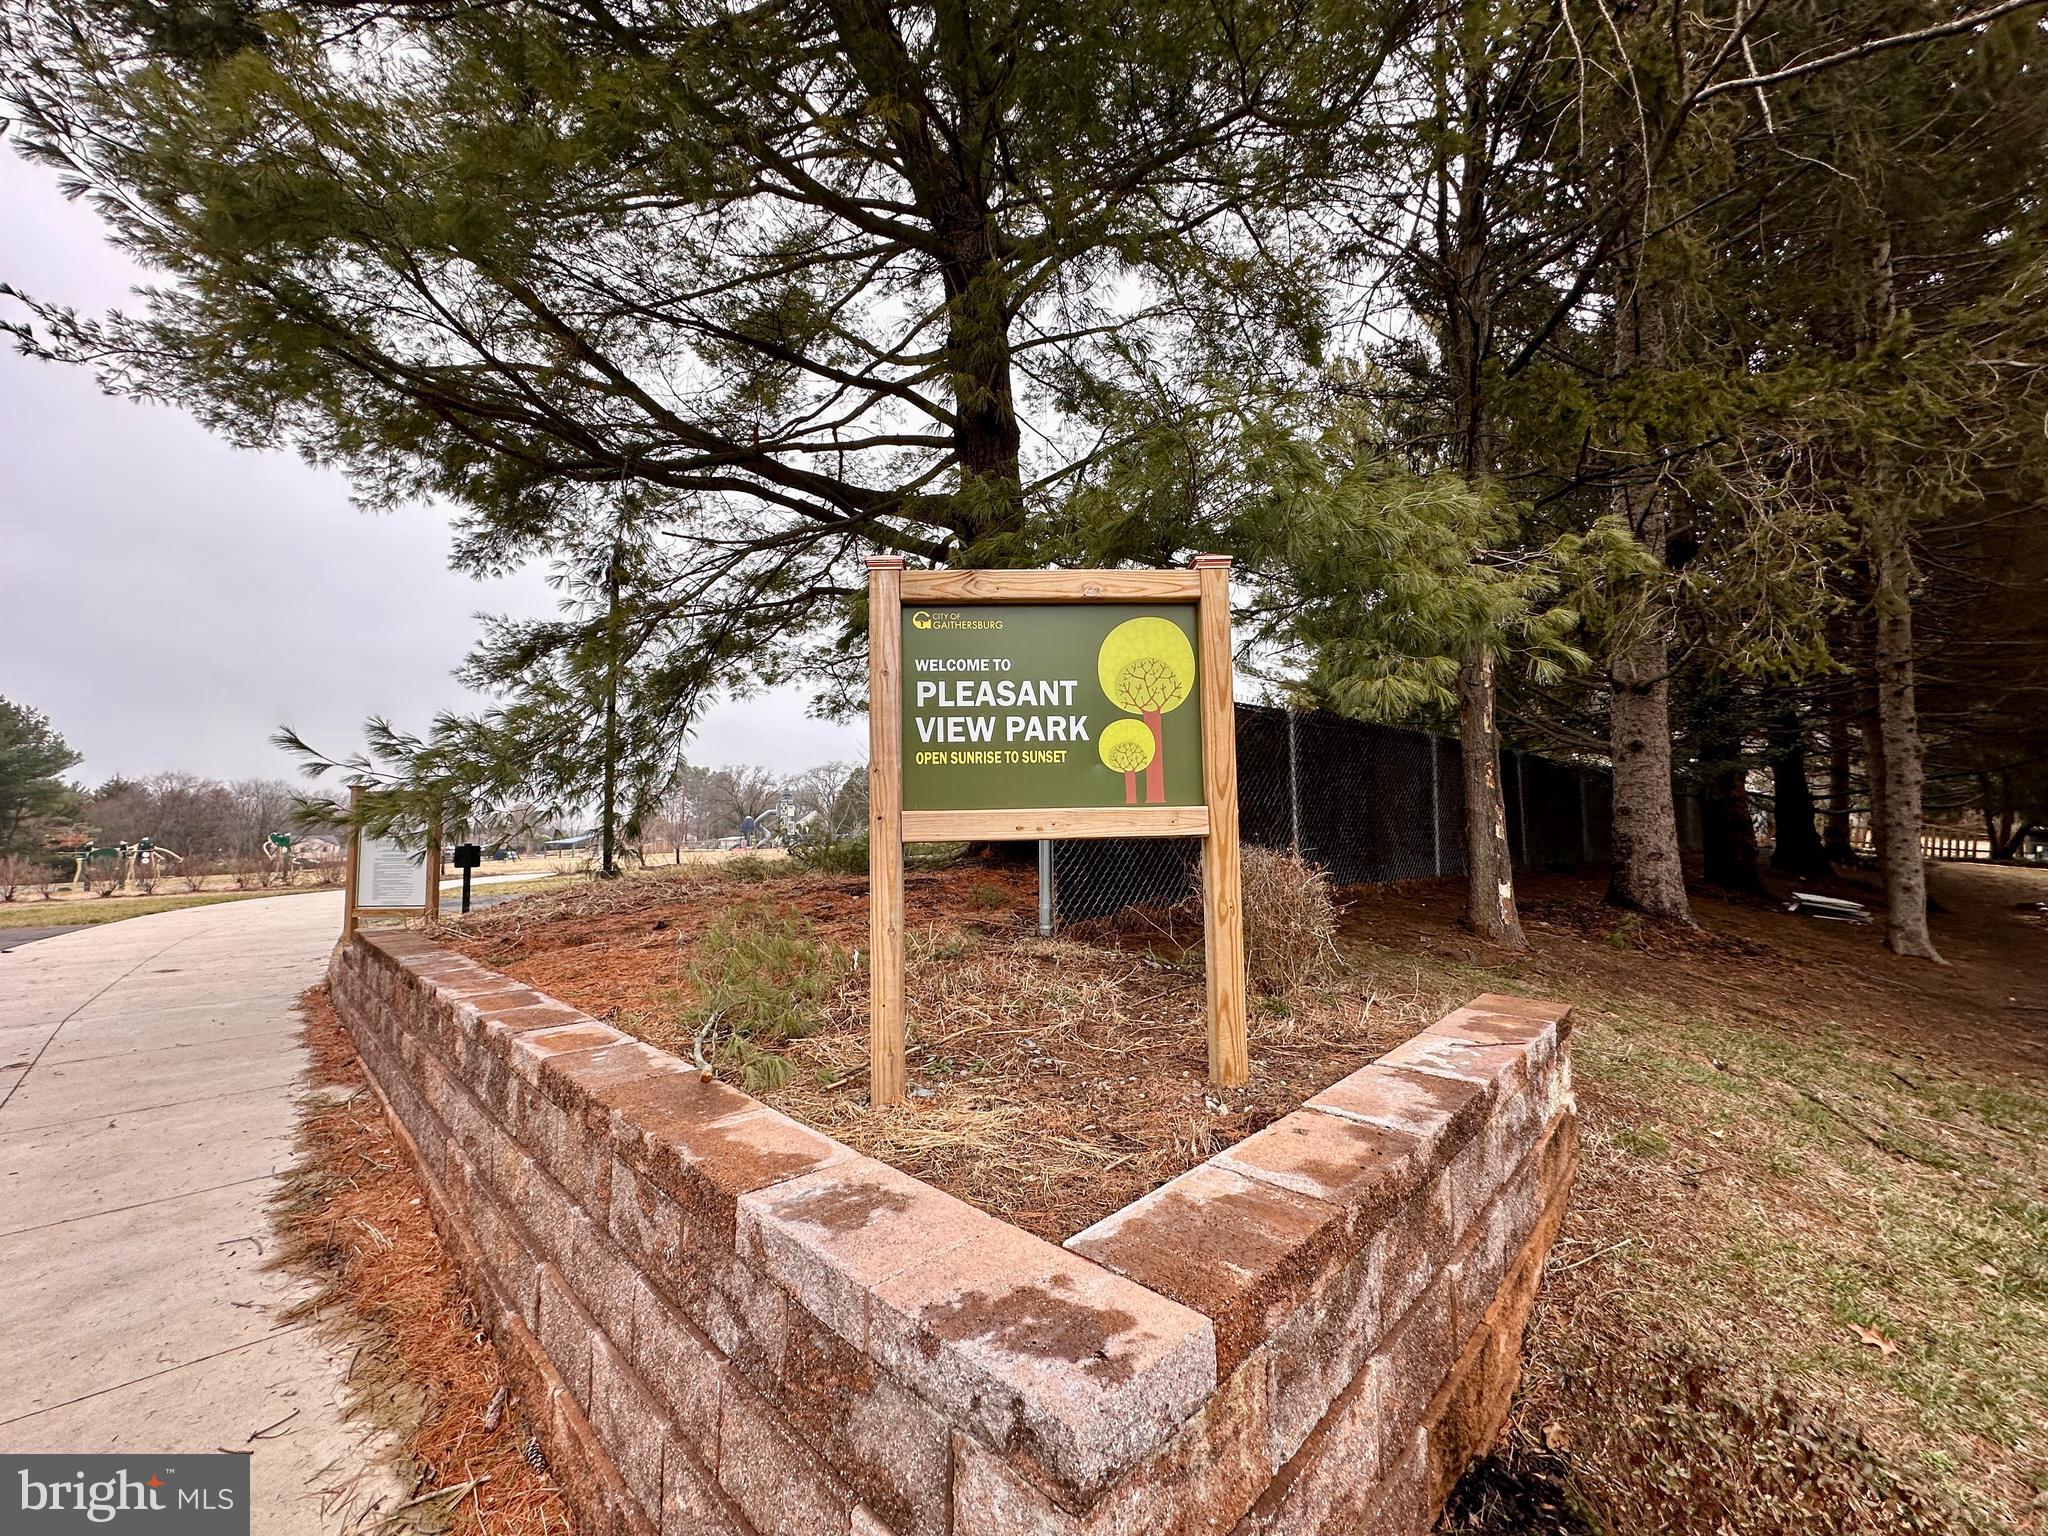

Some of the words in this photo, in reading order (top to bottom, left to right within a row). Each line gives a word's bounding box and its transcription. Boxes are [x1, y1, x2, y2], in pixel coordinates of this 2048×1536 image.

[932, 612, 949, 620] CITY
[950, 612, 961, 620] OF
[932, 620, 1003, 630] GAITHERSBURG
[915, 659, 990, 672] WELCOME
[992, 658, 1012, 671] TO
[916, 680, 1078, 707] PLEASANT
[915, 716, 996, 743] VIEW
[1006, 715, 1090, 742] PARK
[915, 751, 948, 765] OPEN
[950, 751, 1002, 764] SUNRISE
[1004, 750, 1019, 764] TO
[1021, 750, 1067, 763] SUNSET
